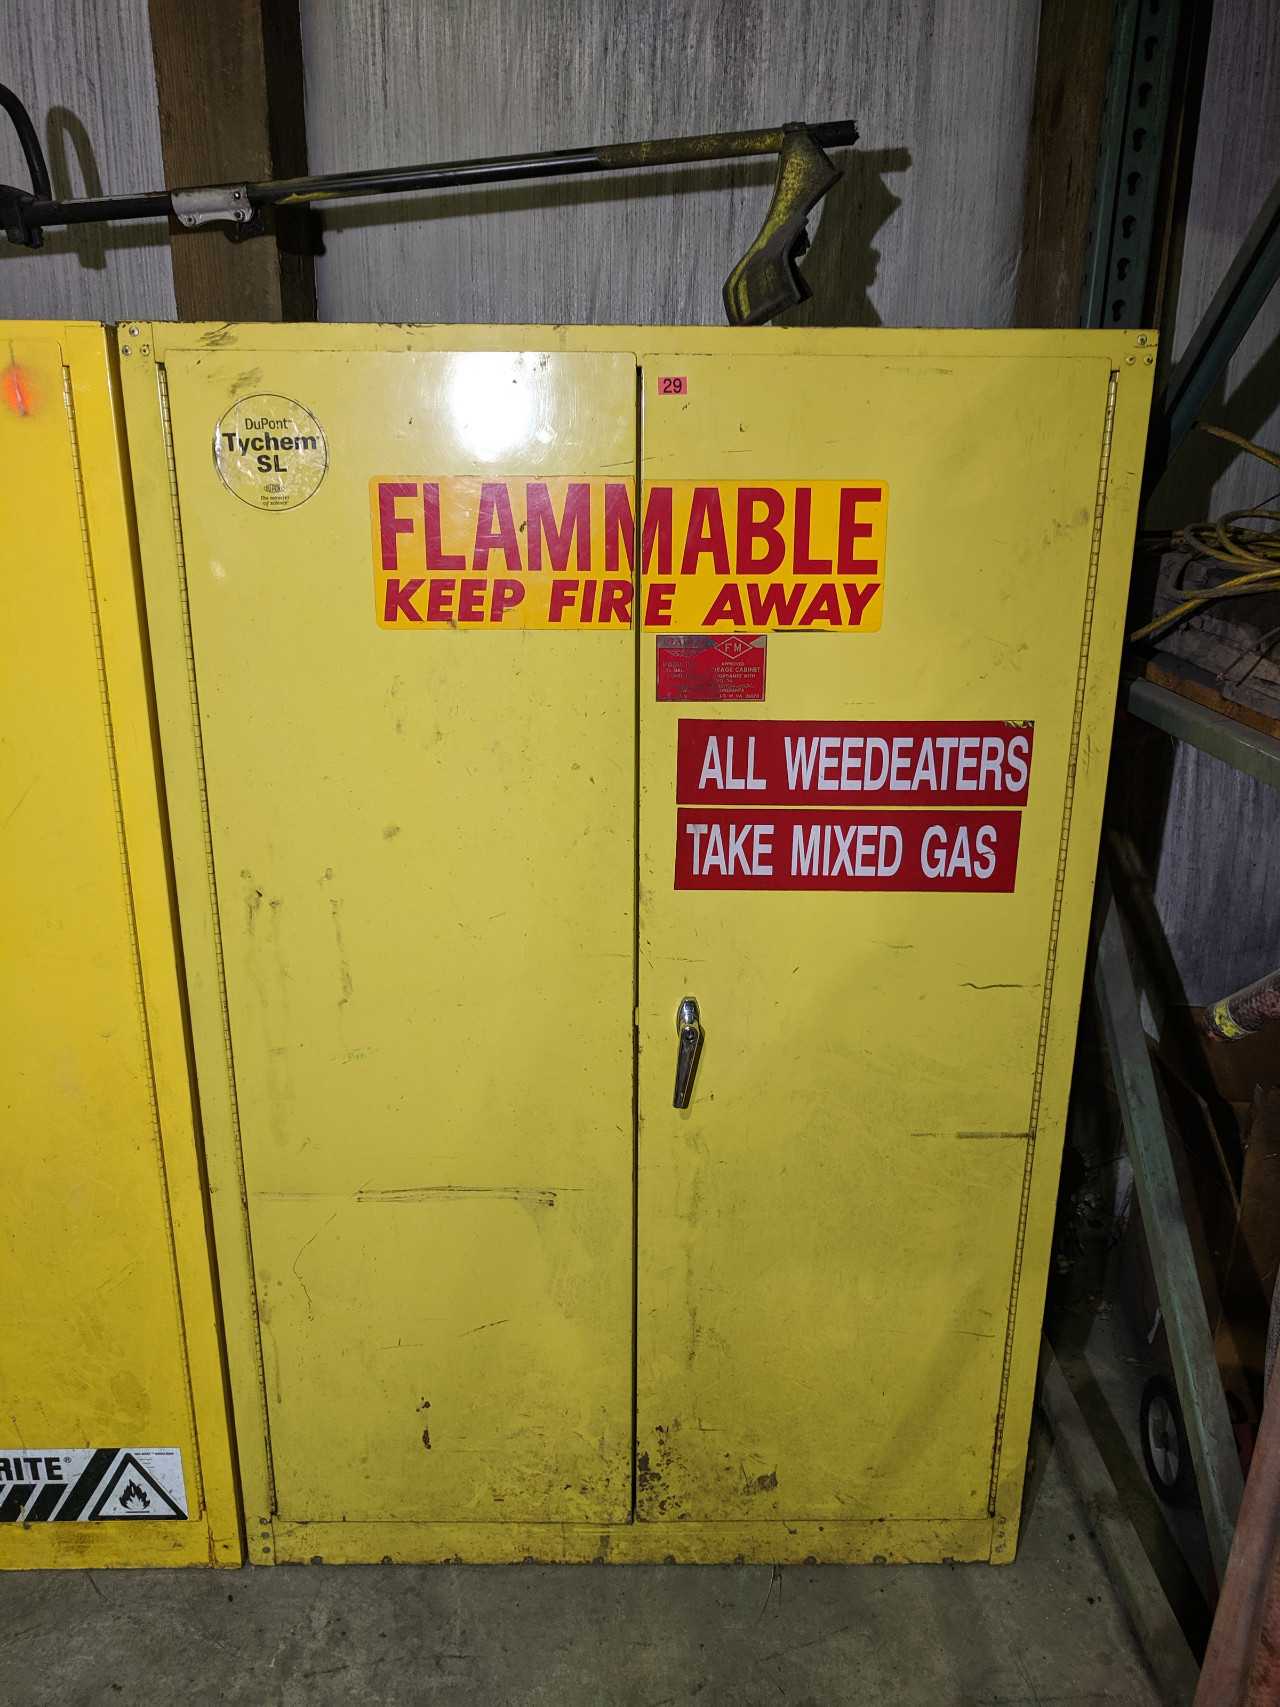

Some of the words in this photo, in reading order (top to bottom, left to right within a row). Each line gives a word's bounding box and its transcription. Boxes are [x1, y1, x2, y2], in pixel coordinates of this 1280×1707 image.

[663, 378, 682, 393] 29
[244, 418, 288, 430] DuPont
[222, 432, 317, 456] Tychem
[257, 454, 287, 473] SL
[378, 483, 882, 575] FLAMMABLE
[384, 579, 525, 622] KEEP
[548, 580, 676, 626] FIRE
[701, 583, 880, 626] AWAY
[724, 642, 742, 653] FM
[698, 736, 767, 790] ALL
[784, 736, 1029, 793] WEEDEATERS
[686, 824, 774, 876] TAKE
[791, 825, 903, 877] MIXED
[920, 825, 997, 879] GAS
